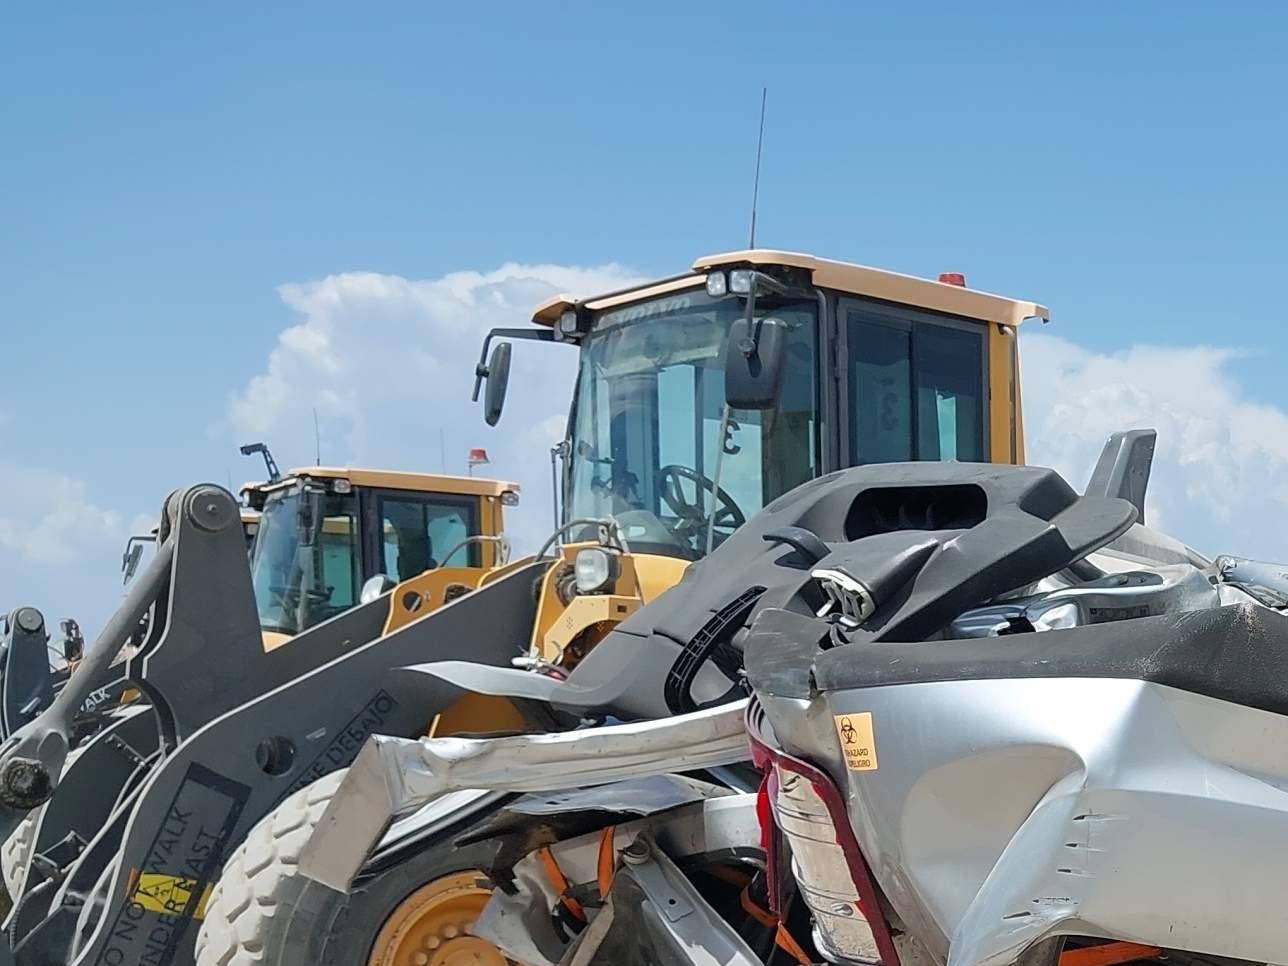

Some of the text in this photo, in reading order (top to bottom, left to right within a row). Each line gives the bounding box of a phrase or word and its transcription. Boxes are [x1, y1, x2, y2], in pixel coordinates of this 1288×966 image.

[80, 687, 111, 713] ALK
[326, 696, 393, 766] DEBAJO
[116, 882, 147, 942] NOT
[151, 805, 193, 873] WALK
